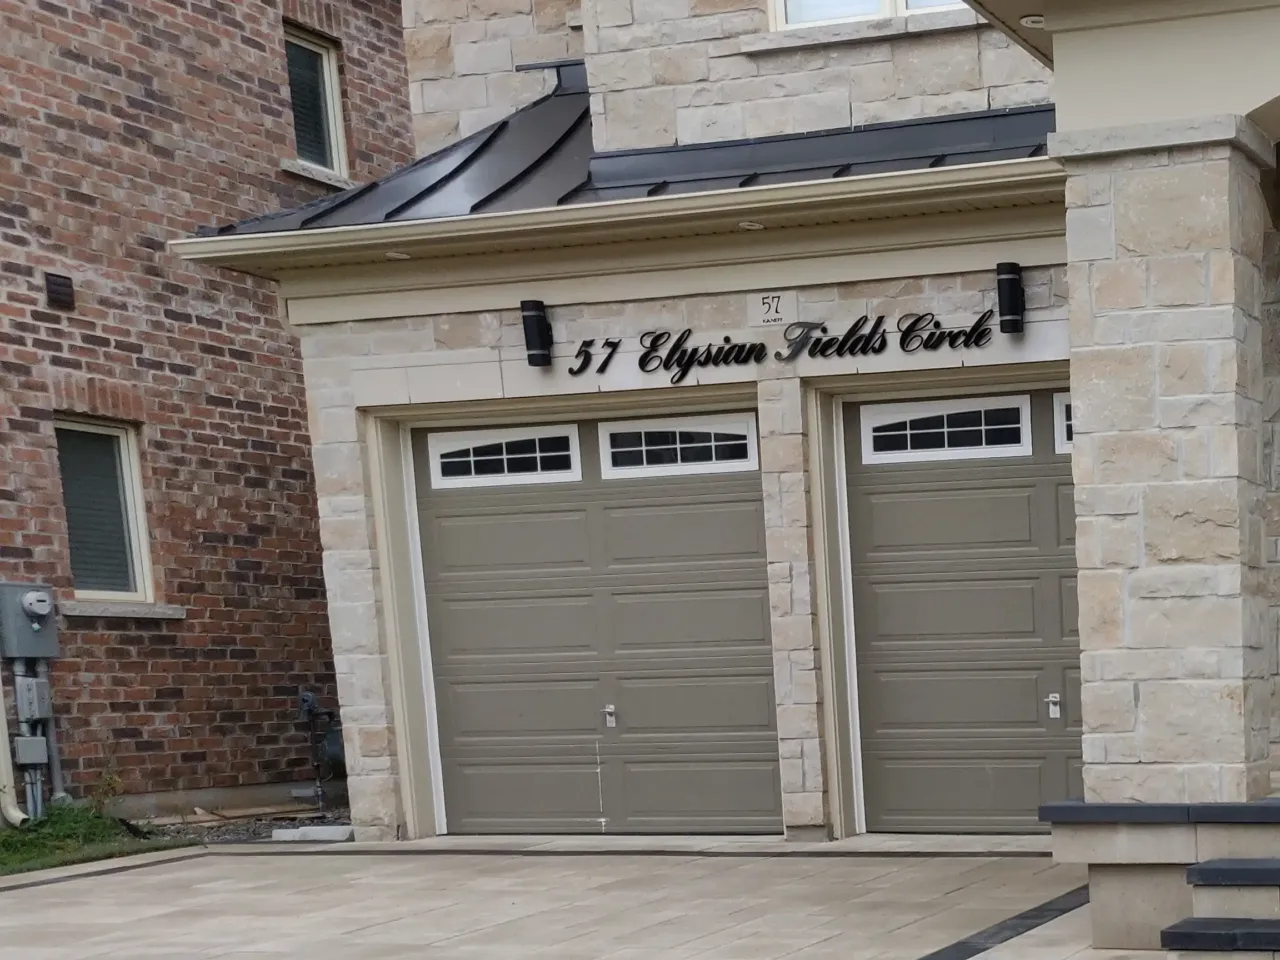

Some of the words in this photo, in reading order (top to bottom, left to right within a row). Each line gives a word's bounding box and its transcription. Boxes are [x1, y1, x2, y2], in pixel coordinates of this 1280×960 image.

[761, 296, 781, 315] 57
[568, 338, 622, 376] 57
[639, 329, 768, 385] Elysian
[774, 315, 888, 362] Fields
[896, 309, 995, 352] Circle
